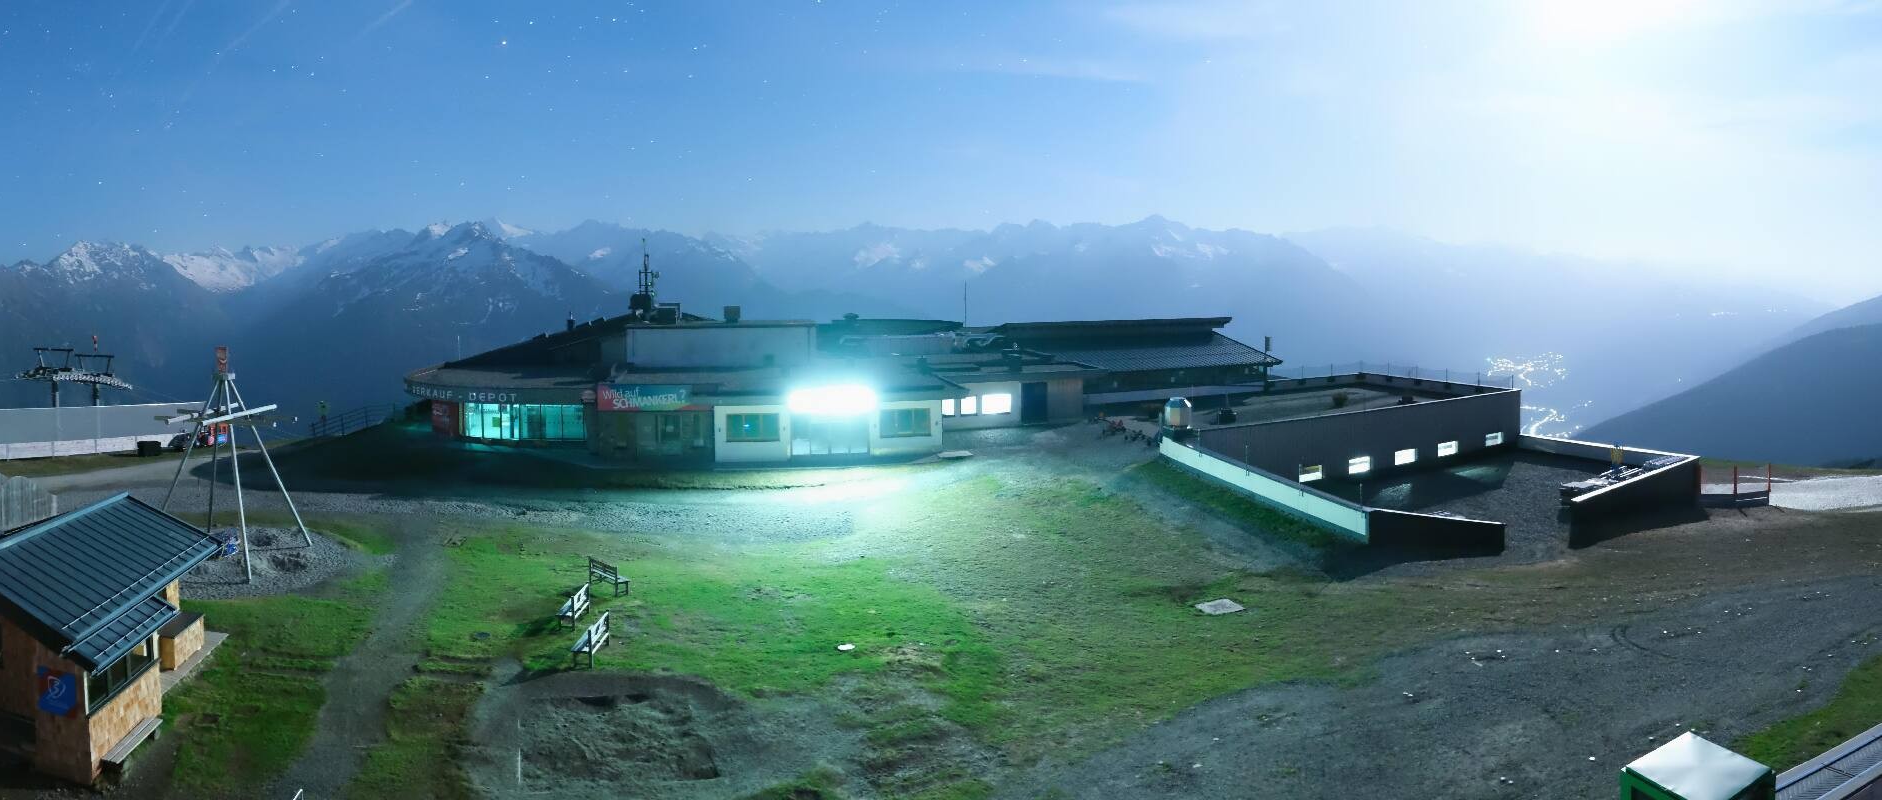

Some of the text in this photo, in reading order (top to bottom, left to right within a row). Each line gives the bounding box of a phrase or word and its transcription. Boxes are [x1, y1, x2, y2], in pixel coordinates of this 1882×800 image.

[469, 392, 517, 402] DEPOT
[602, 386, 640, 399] Wild auf
